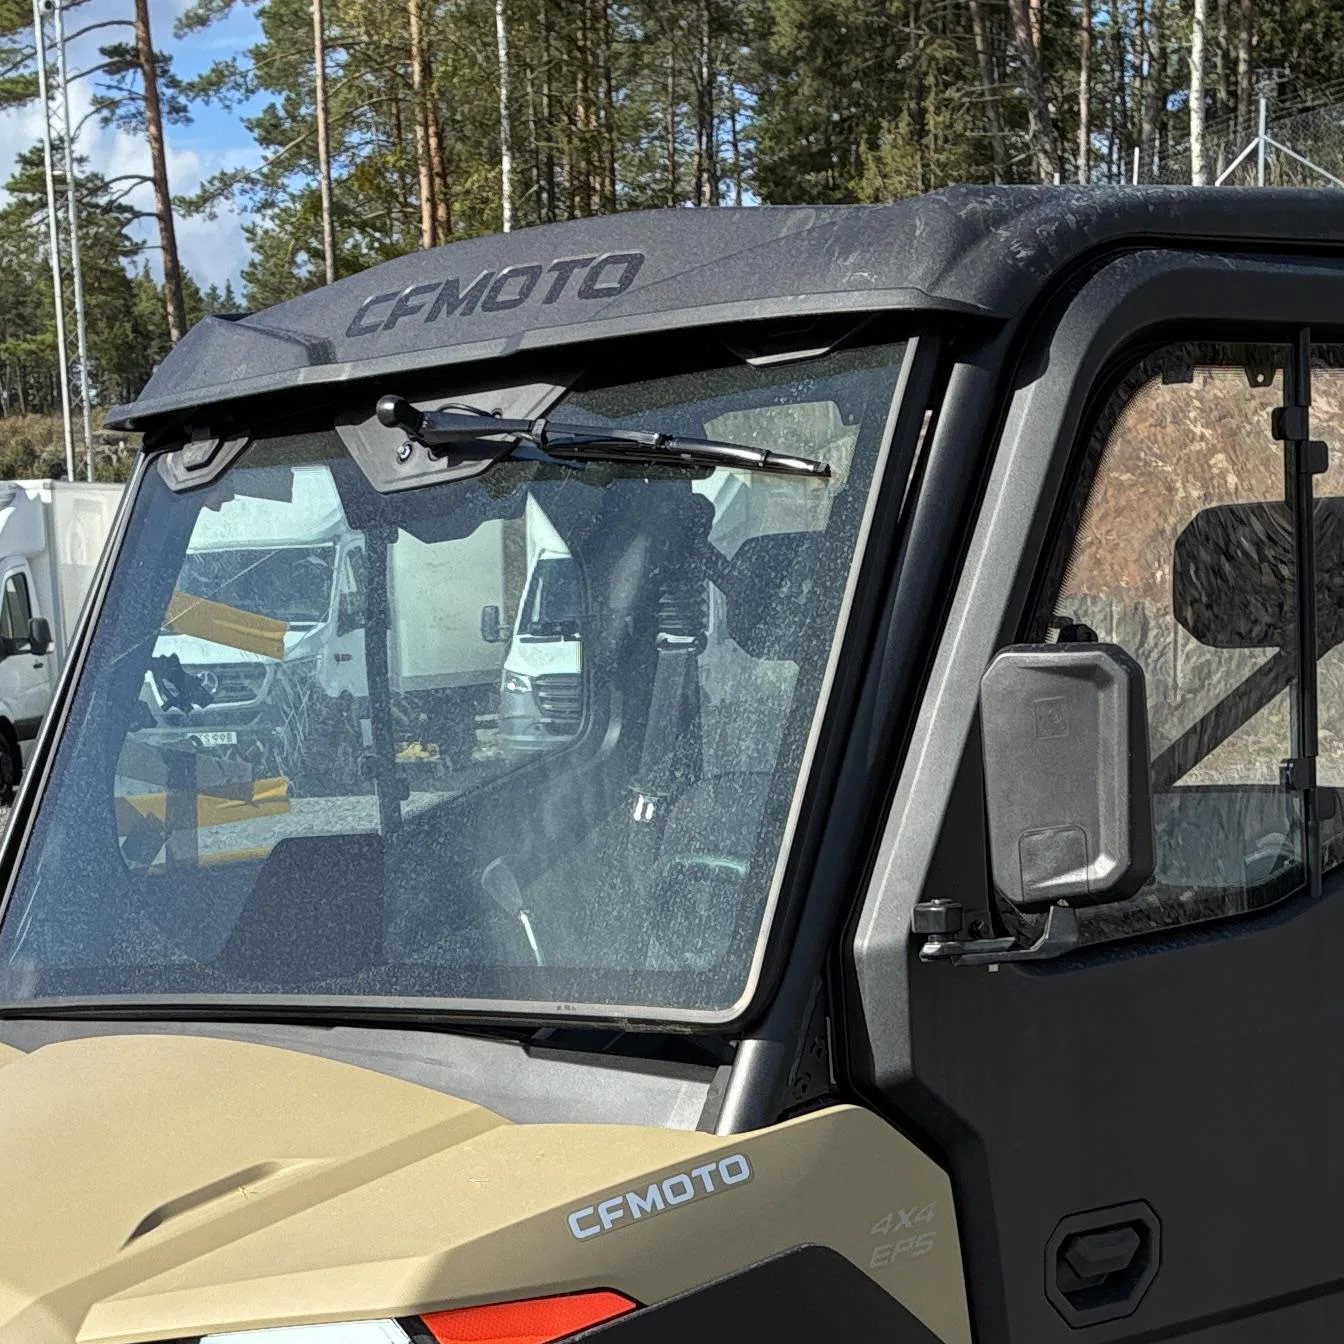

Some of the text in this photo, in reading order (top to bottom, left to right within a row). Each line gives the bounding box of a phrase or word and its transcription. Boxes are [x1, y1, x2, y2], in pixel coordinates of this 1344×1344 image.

[346, 250, 645, 338] CFMOTO
[568, 1153, 751, 1240] CFMOTO
[869, 1231, 937, 1269] EPS
